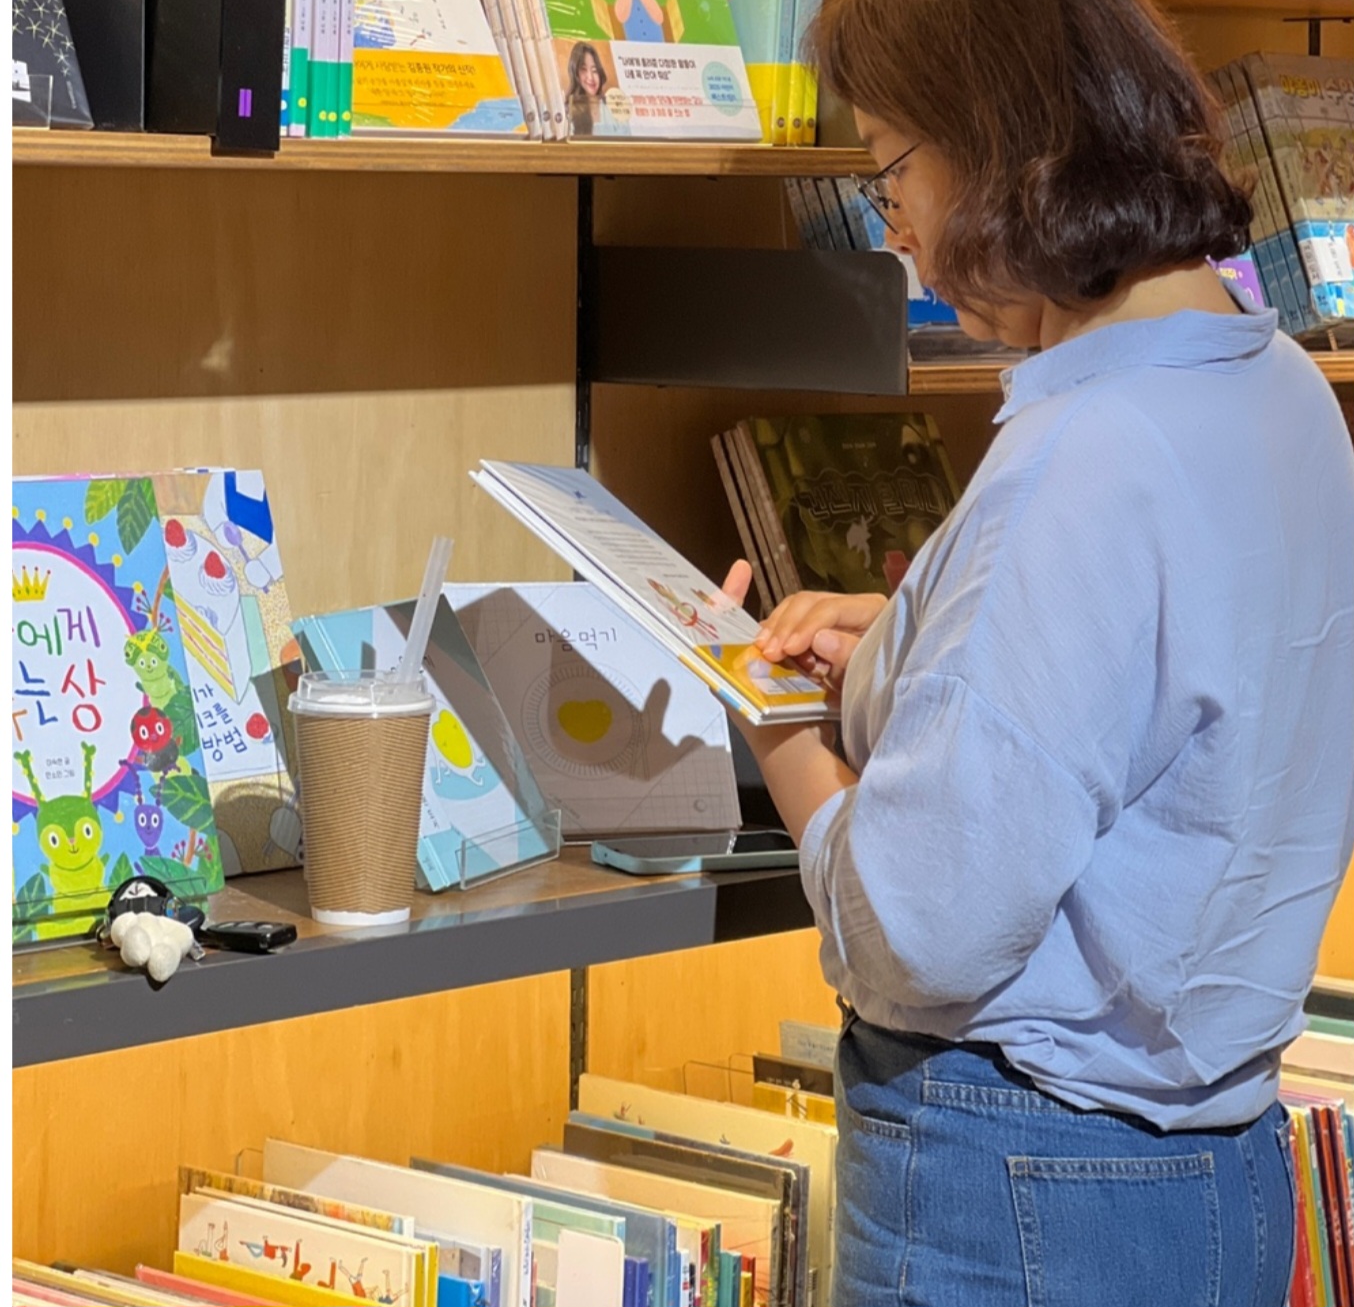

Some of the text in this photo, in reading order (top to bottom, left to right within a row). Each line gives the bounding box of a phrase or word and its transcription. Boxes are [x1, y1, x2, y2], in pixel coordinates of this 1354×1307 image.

[12, 605, 101, 656] 에게
[534, 628, 618, 652] 마음먹기
[61, 658, 107, 733] 상
[201, 725, 248, 762] 방법
